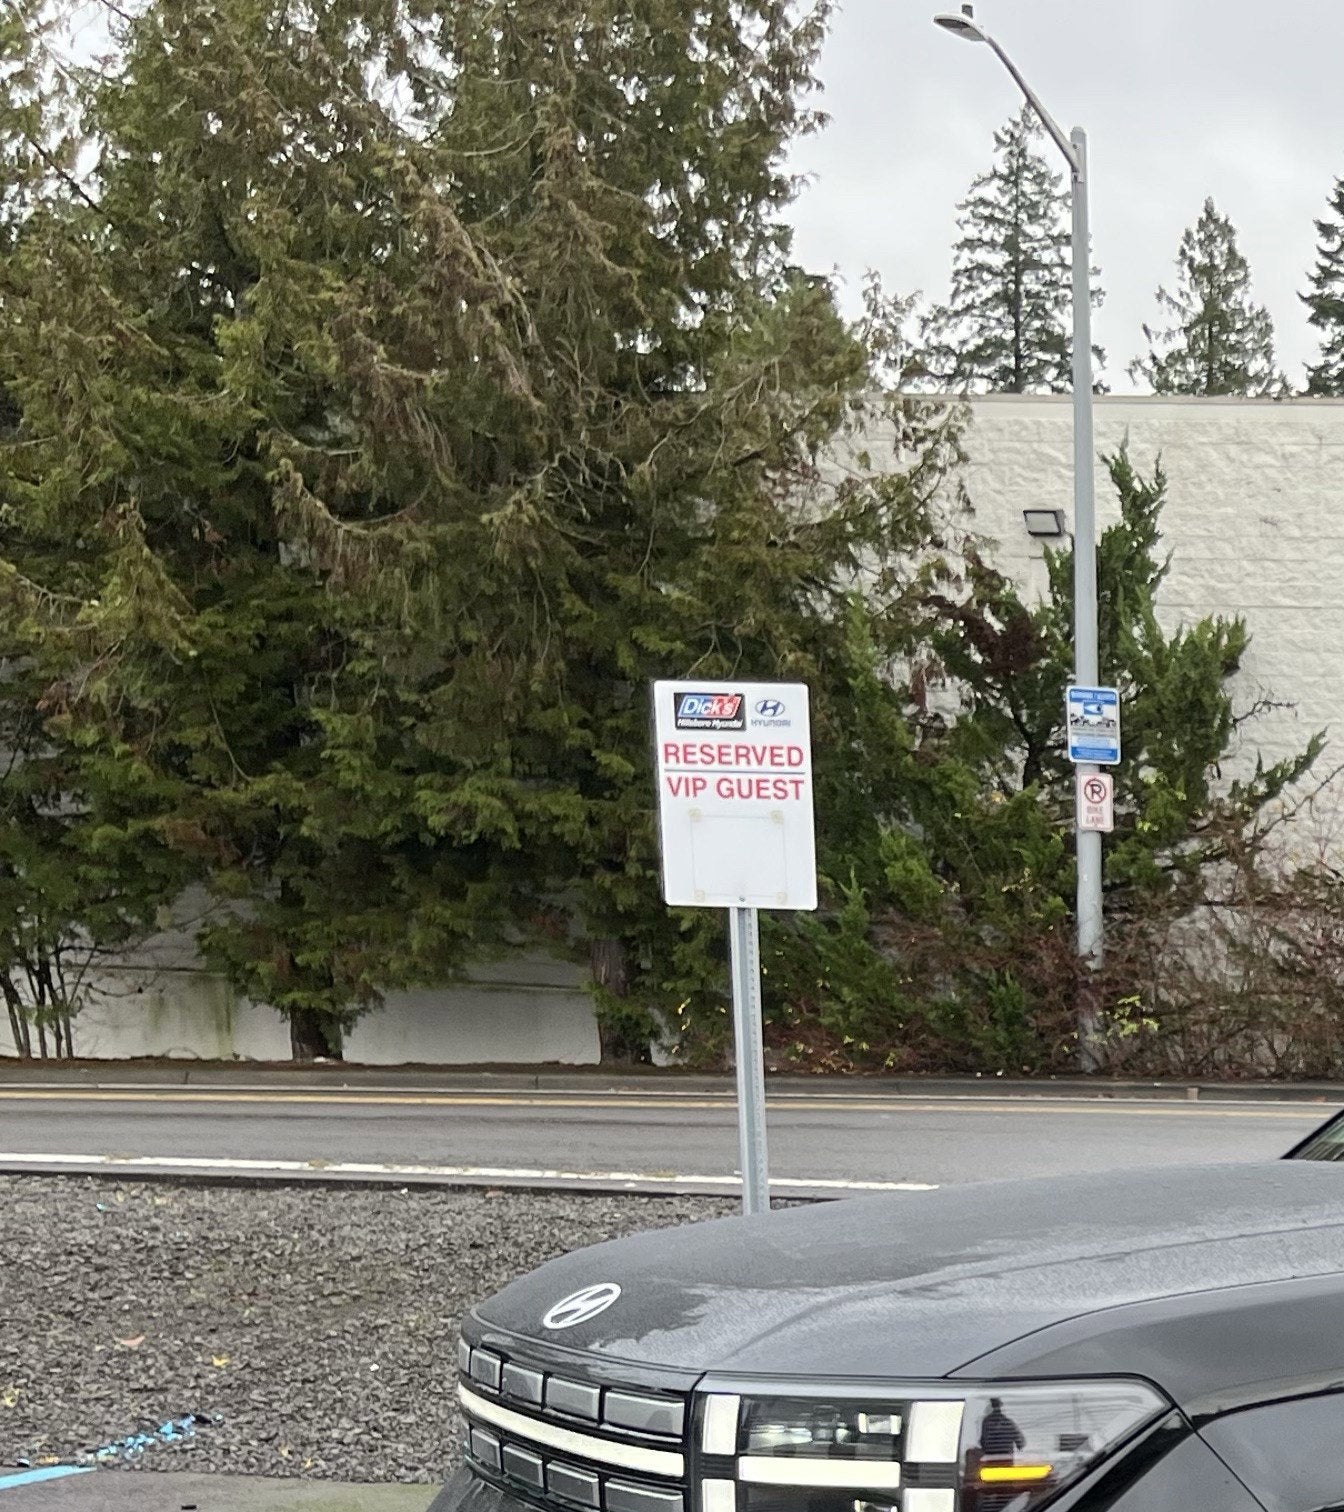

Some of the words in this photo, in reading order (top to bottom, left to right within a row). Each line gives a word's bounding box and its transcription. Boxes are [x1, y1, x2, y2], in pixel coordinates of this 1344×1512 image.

[663, 742, 805, 767] RESERVED
[667, 775, 708, 799] VIP
[715, 777, 806, 801] GUEST
